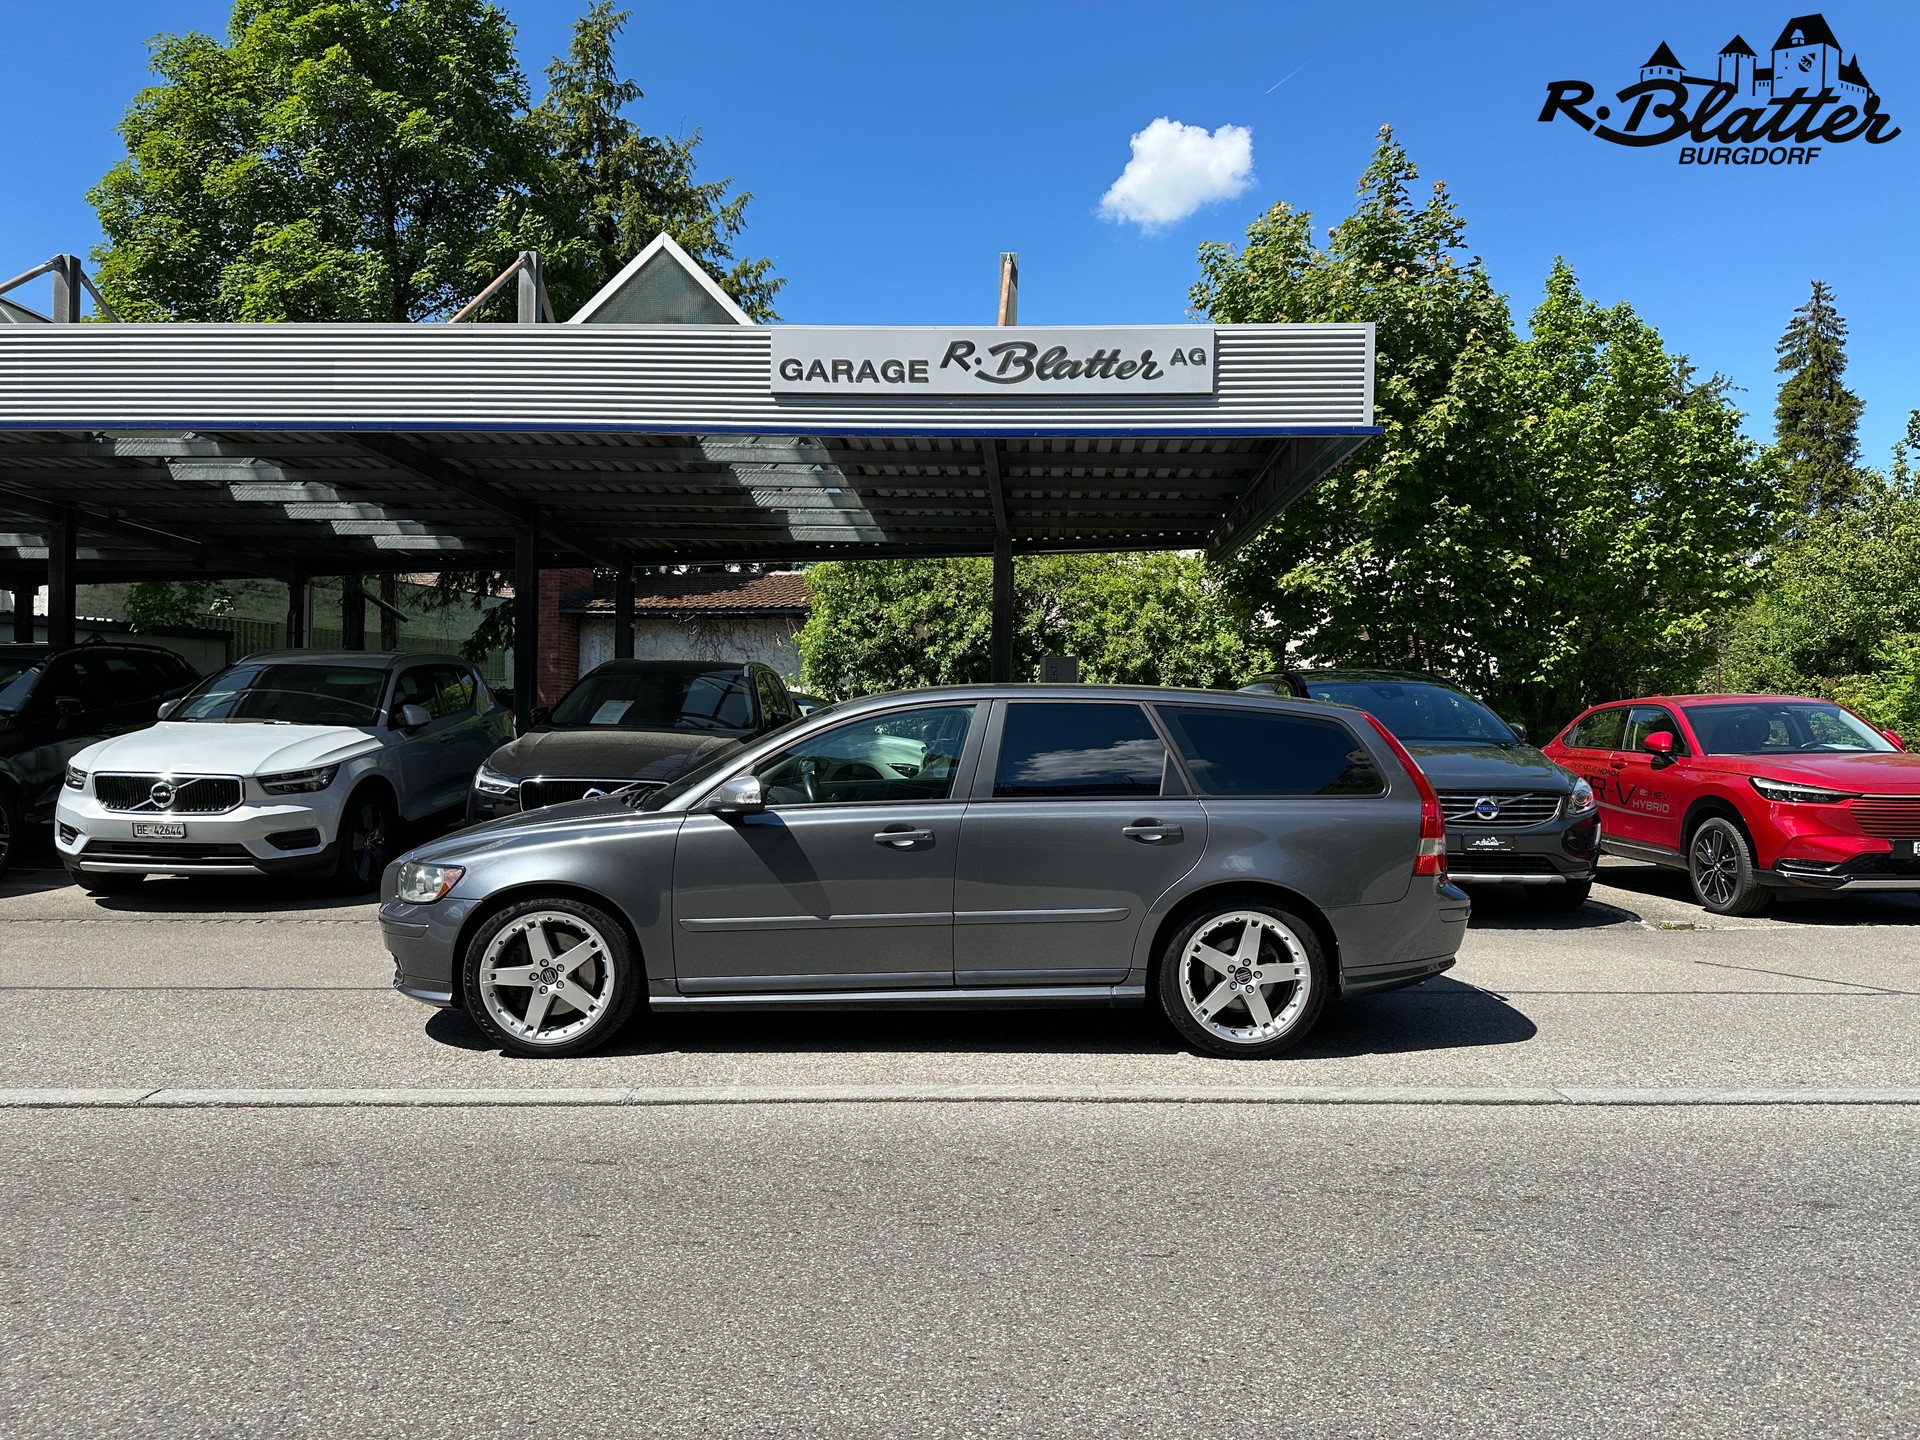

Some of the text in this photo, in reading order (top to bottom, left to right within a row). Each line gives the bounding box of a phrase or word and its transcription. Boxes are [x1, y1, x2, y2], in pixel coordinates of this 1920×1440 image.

[779, 358, 930, 384] GARAGE
[974, 340, 1165, 384] Blatter
[1169, 347, 1207, 366] AG
[1597, 768, 1620, 777] HONDA
[1583, 774, 1638, 805] R-V
[1632, 799, 1670, 813] HYBRID
